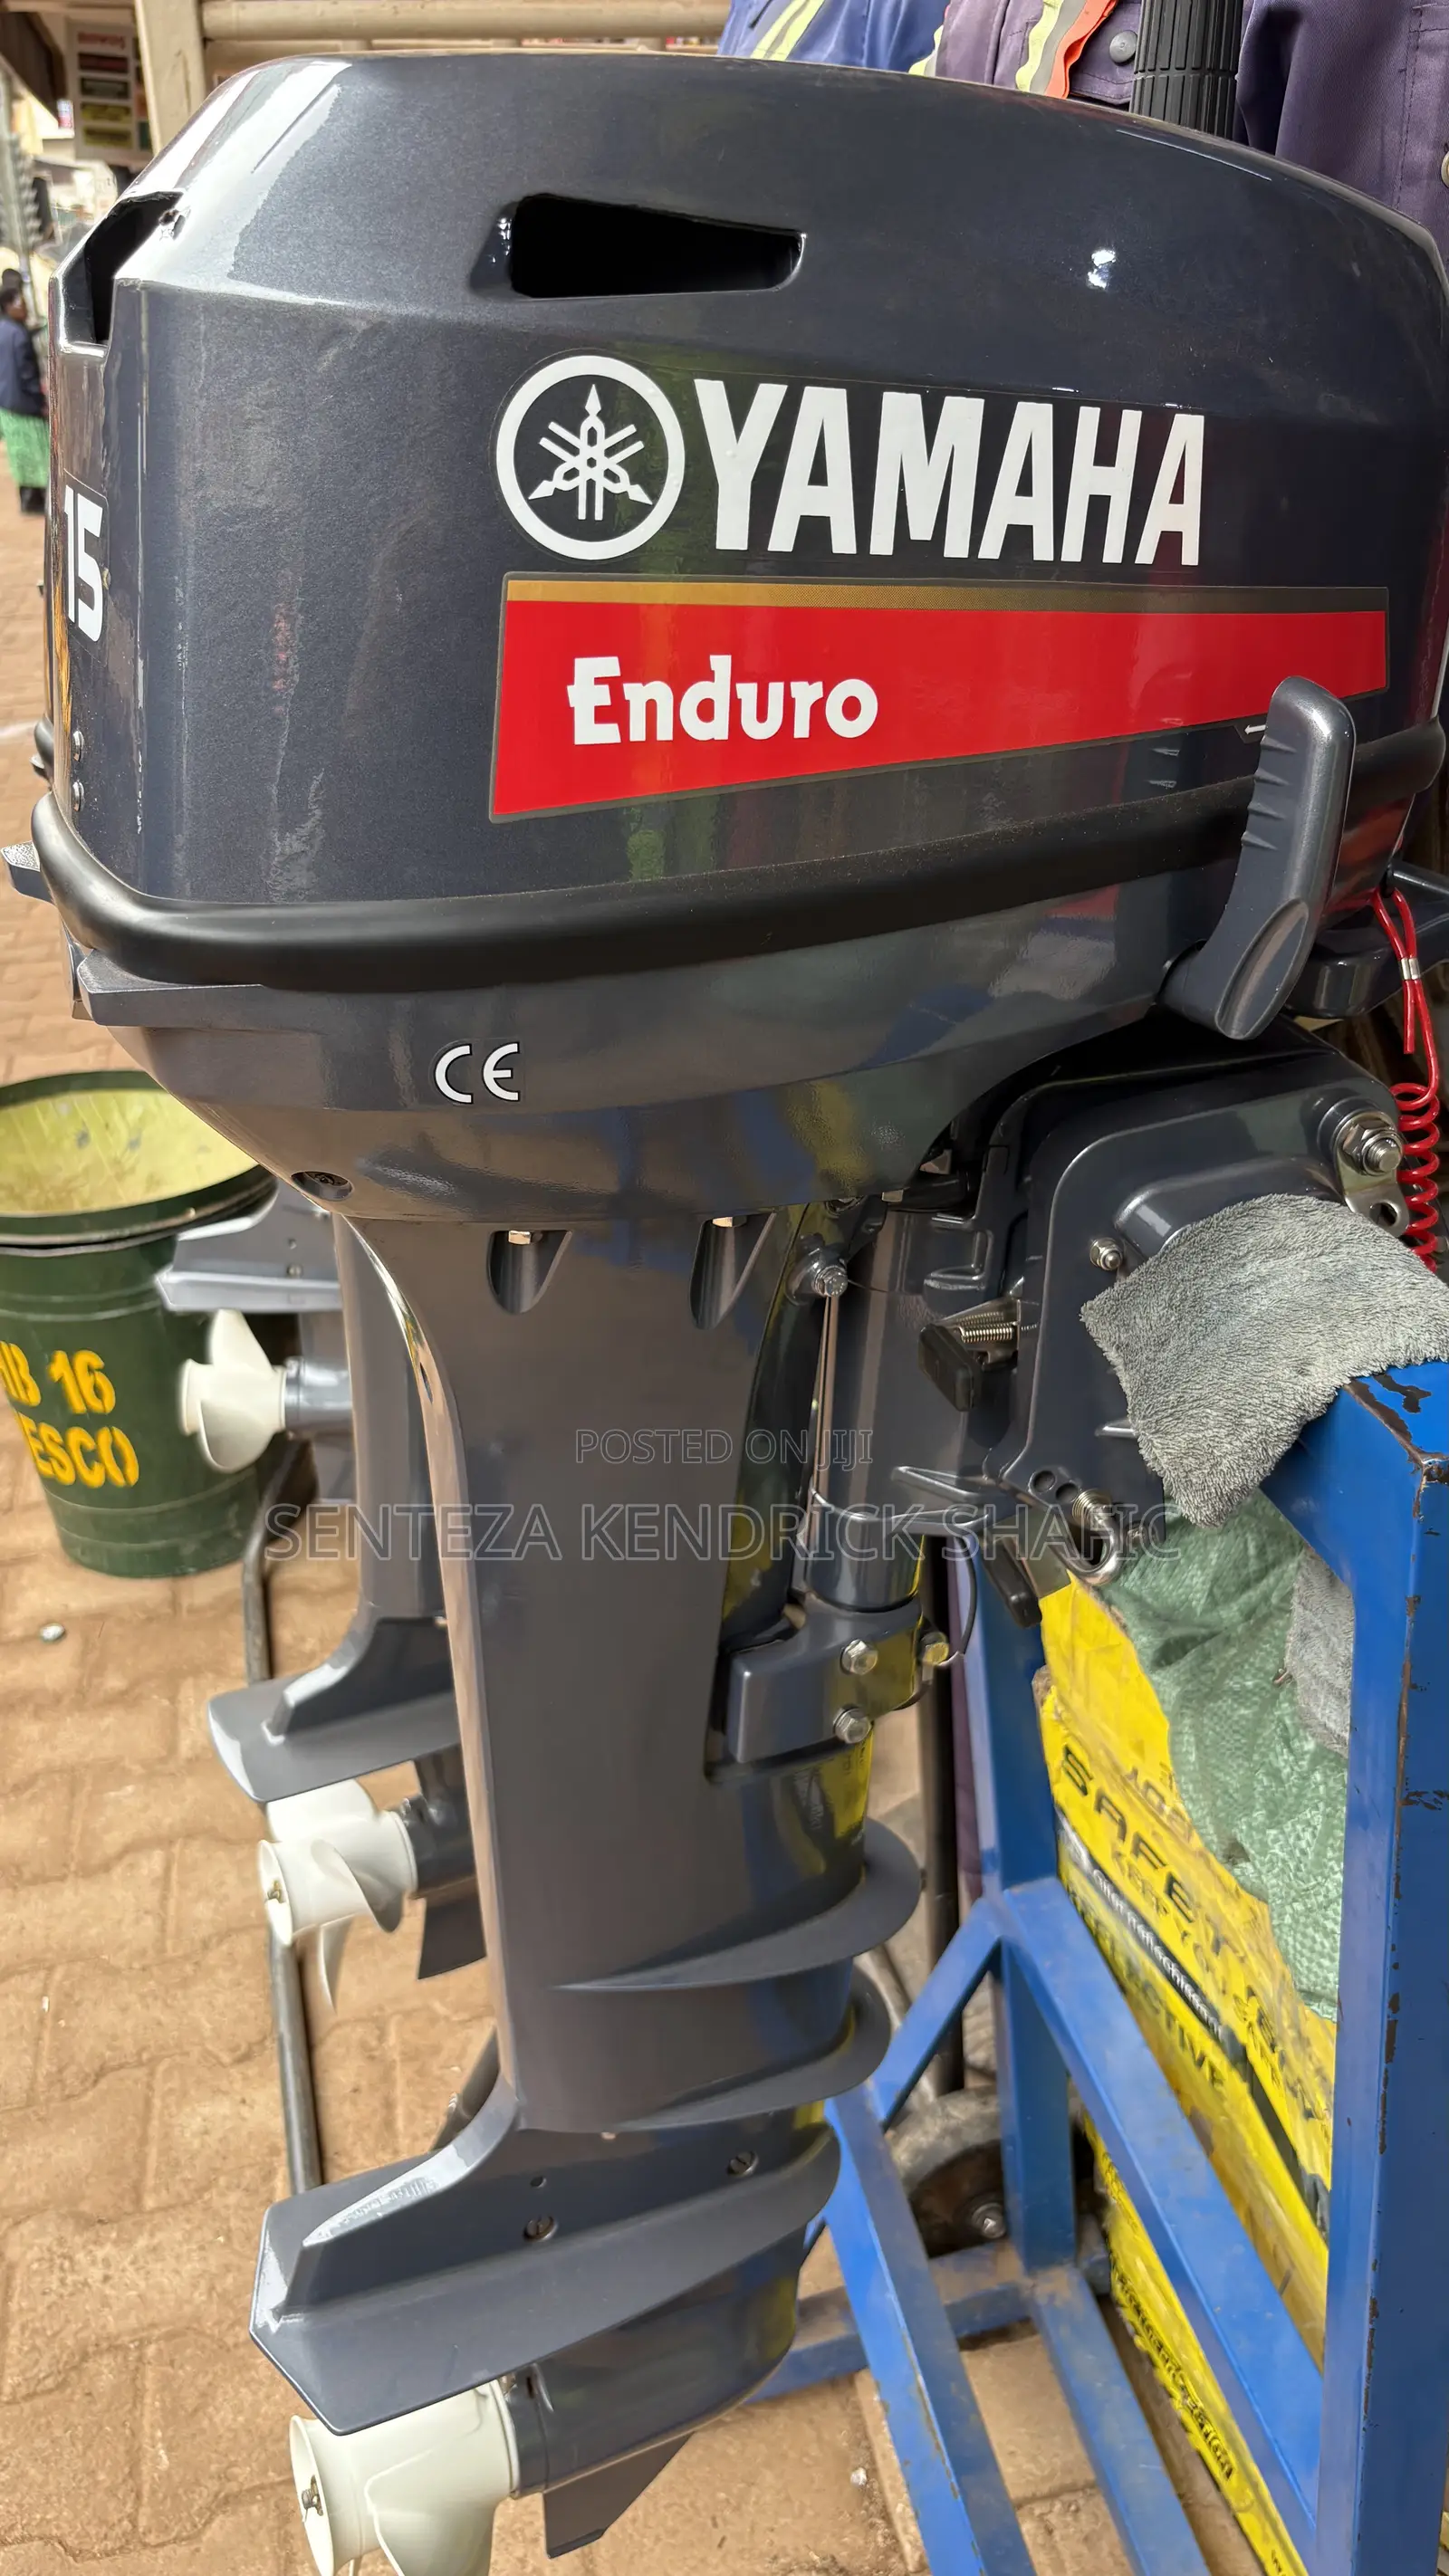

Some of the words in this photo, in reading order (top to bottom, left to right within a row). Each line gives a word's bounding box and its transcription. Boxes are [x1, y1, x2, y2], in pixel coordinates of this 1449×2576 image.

[694, 378, 1204, 567] YAMAHA
[64, 484, 103, 642] 15
[567, 655, 878, 746] Enduro
[435, 1043, 521, 1104] CE
[48, 1349, 116, 1414] 16
